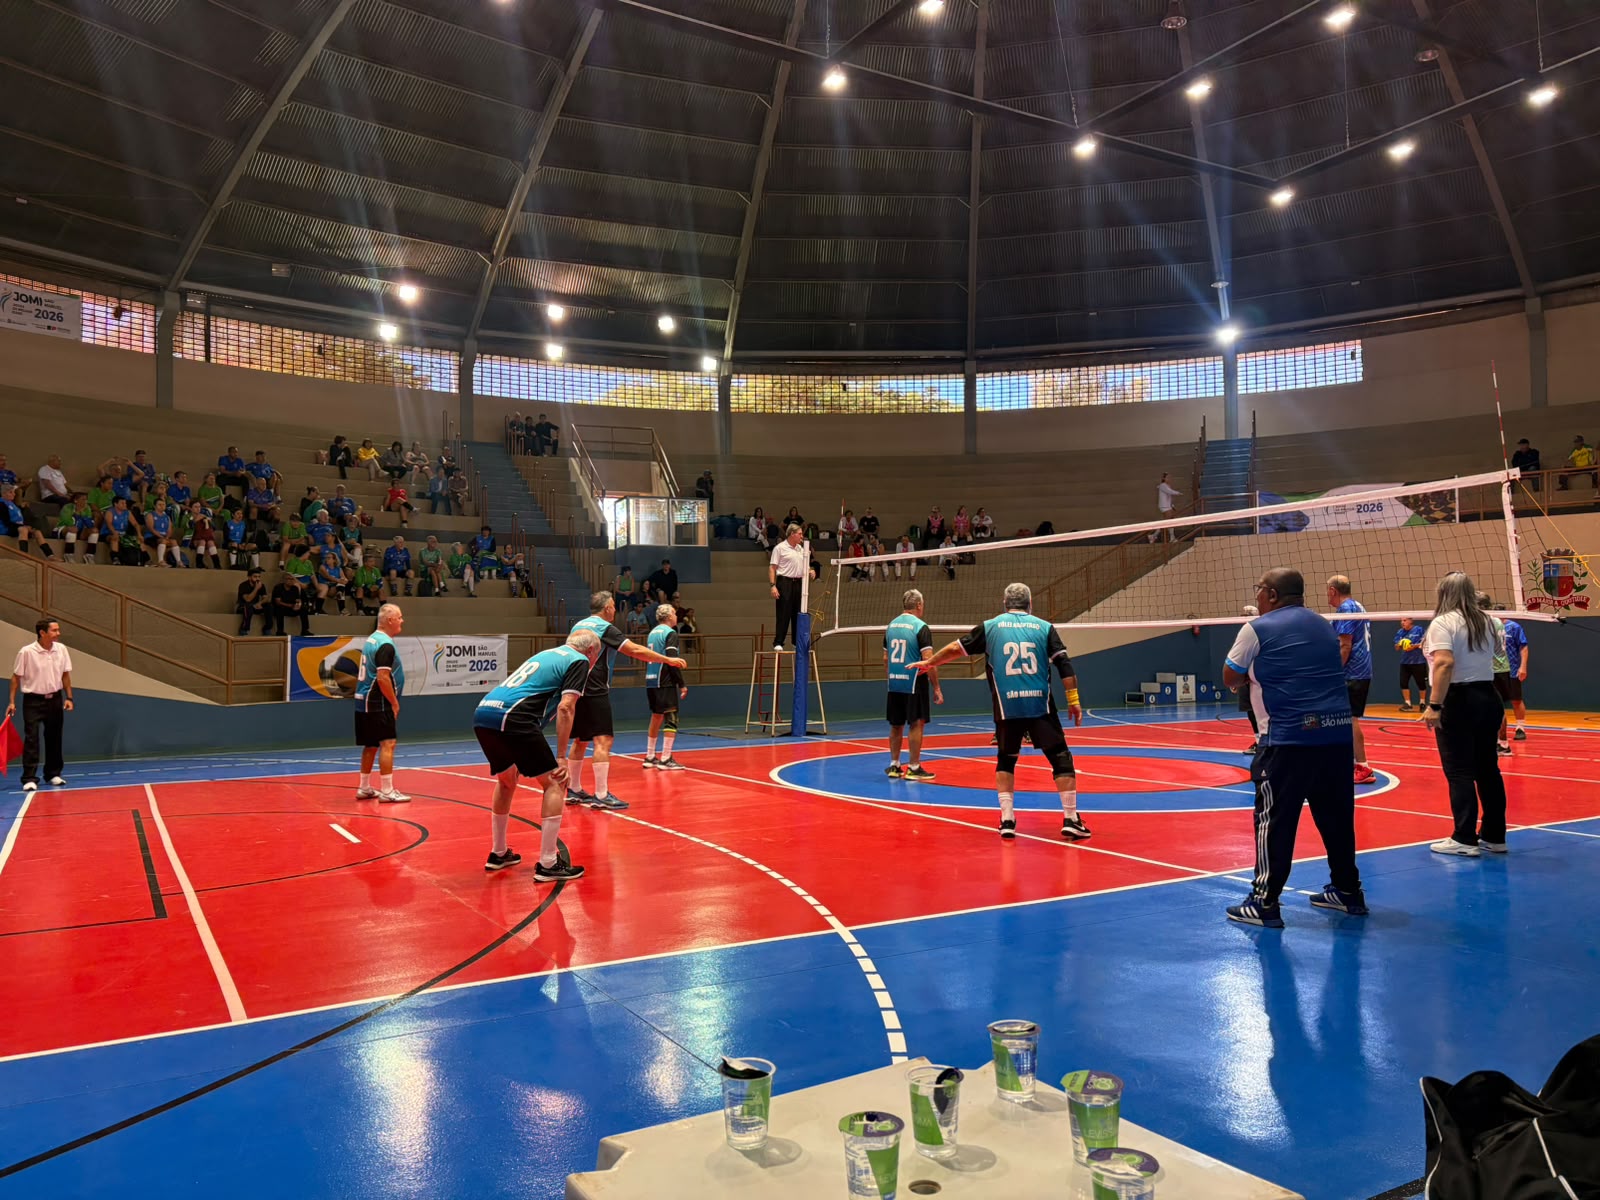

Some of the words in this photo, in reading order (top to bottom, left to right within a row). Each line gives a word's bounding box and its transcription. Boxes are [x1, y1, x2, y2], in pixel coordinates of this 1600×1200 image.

[13, 292, 43, 306] JOMI
[34, 309, 64, 322] 2026
[1356, 502, 1383, 513] 2026
[446, 646, 476, 657] JOMI
[890, 638, 907, 663] 27
[1003, 641, 1038, 676] 25
[469, 660, 497, 671] 2026
[1006, 690, 1018, 699] SÃO
[1321, 718, 1335, 727] SÃO
